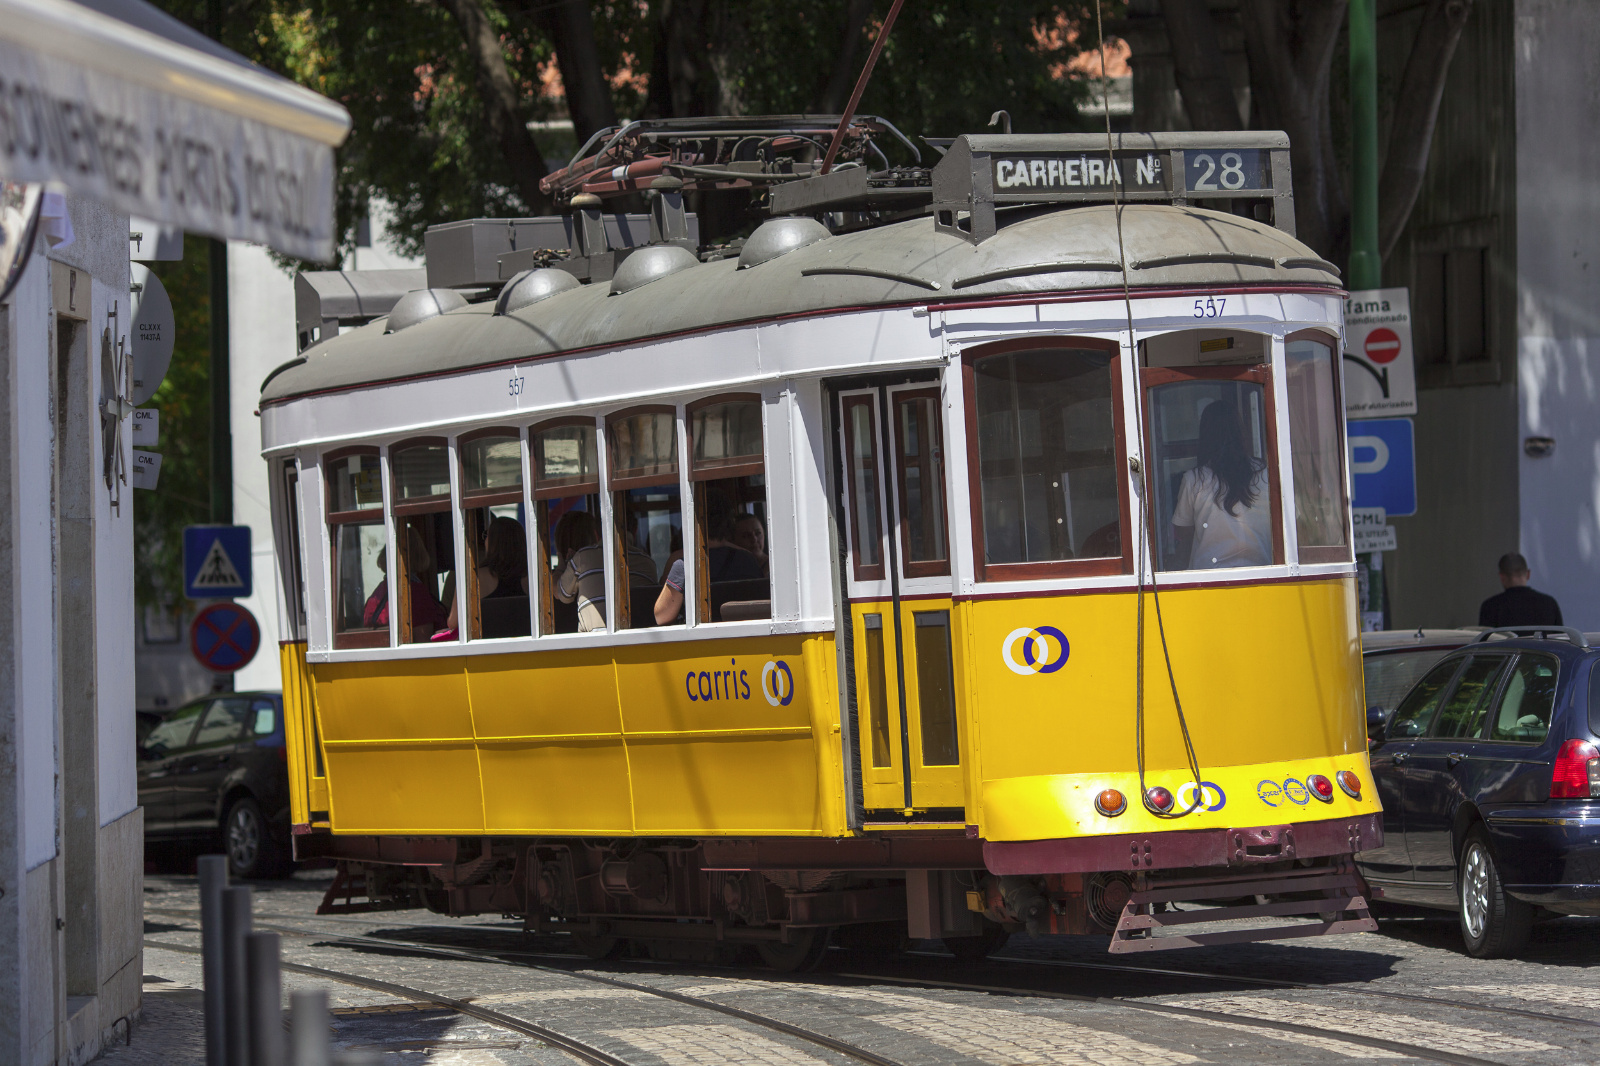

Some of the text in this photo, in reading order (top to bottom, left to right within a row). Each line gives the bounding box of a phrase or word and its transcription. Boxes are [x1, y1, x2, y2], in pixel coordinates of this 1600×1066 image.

[996, 154, 1122, 189] CARREIRA
[1193, 152, 1245, 190] 28
[1193, 298, 1227, 319] 557
[139, 323, 161, 331] CLXXX
[508, 376, 525, 396] 557
[135, 411, 153, 420] CML
[138, 455, 155, 466] CML
[1347, 435, 1390, 501] P
[1352, 514, 1383, 525] CML
[686, 657, 751, 702] carris
